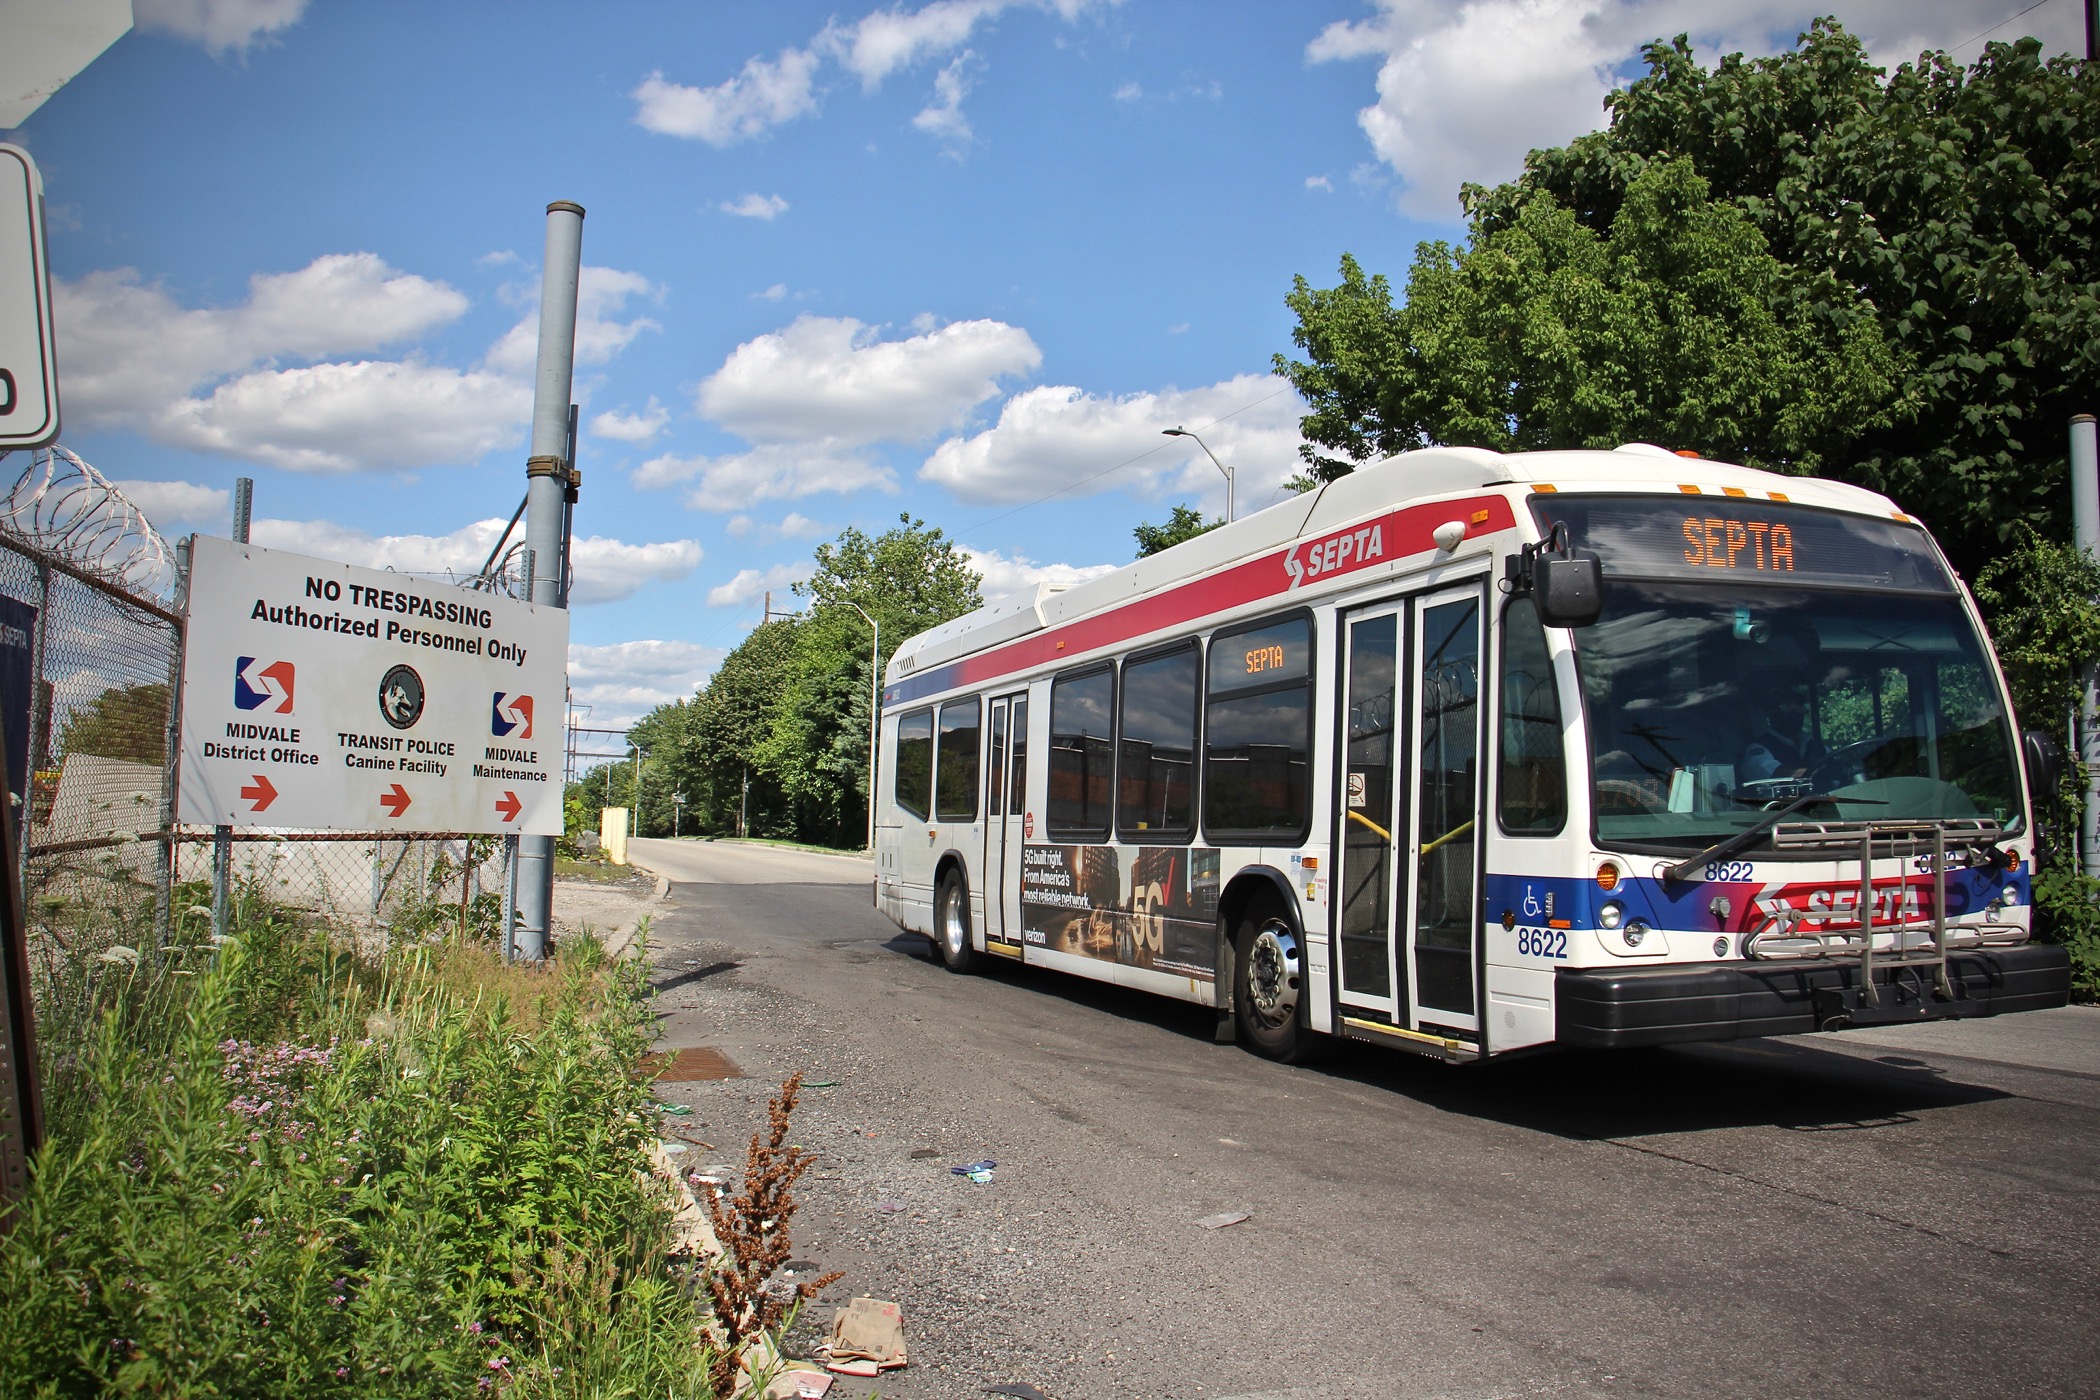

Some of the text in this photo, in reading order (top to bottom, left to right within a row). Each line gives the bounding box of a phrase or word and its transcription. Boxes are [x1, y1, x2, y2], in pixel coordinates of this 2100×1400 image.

[1307, 524, 1382, 576] SEPTA
[1683, 517, 1793, 571] SEPTA
[305, 576, 492, 629] NO TRESPASSING
[4, 625, 28, 650] SEPTA
[251, 599, 527, 667] Authorized Personnel Only
[1246, 645, 1283, 674] SEPTA
[226, 722, 301, 743] MIDVALE
[338, 732, 455, 757] TRANSIT POLICE
[203, 742, 319, 765] District Office
[345, 753, 448, 778] Canine Facility
[485, 747, 538, 764] MIDVALE
[473, 764, 548, 782] Maintenance
[1024, 849, 1033, 865] 5G
[1033, 849, 1047, 865] built
[1024, 867, 1070, 887] From America's
[1704, 860, 1753, 882] 8622
[1023, 887, 1039, 901] most
[1806, 885, 1920, 926] SEPTA
[1132, 881, 1164, 955] 5G
[1024, 927, 1046, 945] verizon
[1518, 927, 1568, 959] 8622
